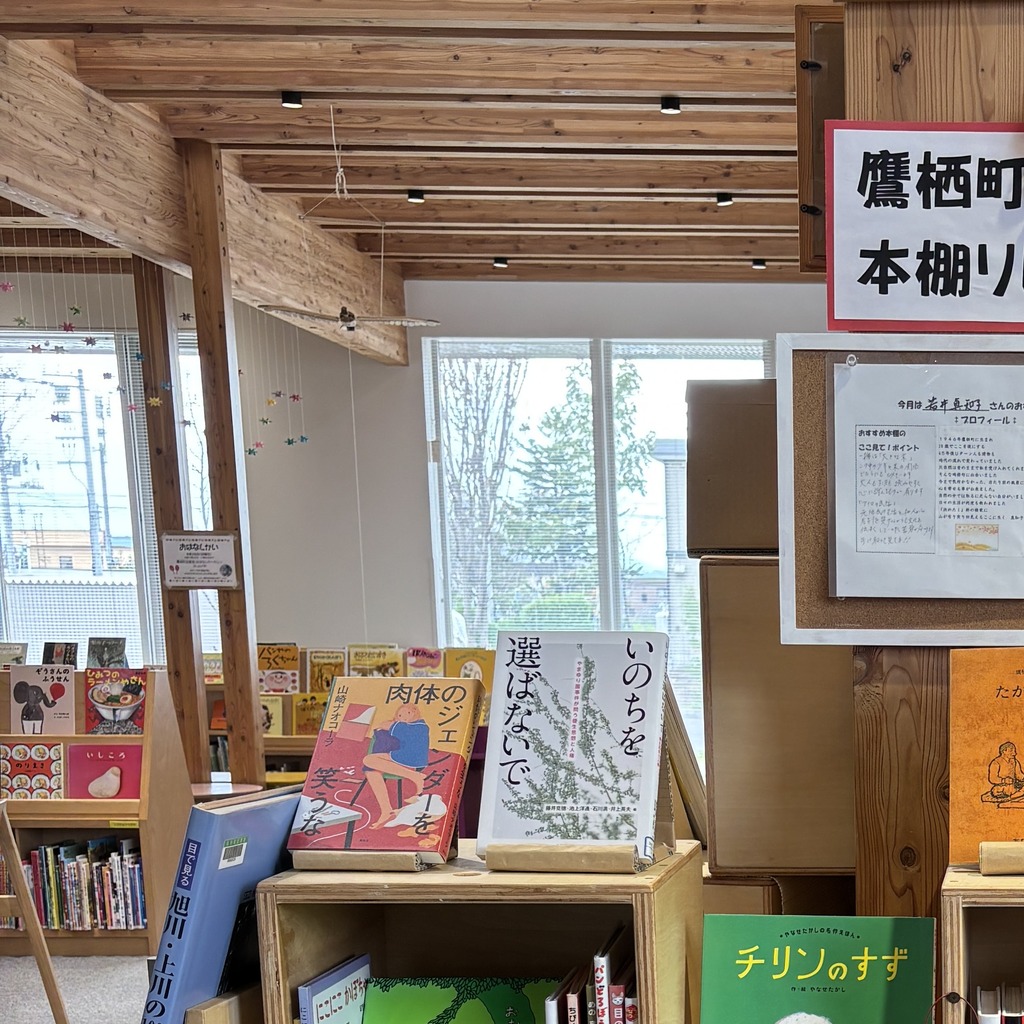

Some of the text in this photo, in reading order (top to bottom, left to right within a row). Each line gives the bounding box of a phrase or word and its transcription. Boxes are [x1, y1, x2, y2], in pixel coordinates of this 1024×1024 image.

[898, 401, 922, 410] 今月は
[961, 416, 1010, 424] プロフィール
[179, 543, 219, 551] おはなしかい
[258, 646, 292, 658] パンやの
[261, 655, 298, 669] ろくちゃん
[86, 670, 120, 678] ひみつの
[88, 676, 146, 686] ラーメンやさん
[385, 684, 467, 705] 肉体の
[620, 637, 654, 756] いのちを
[325, 685, 349, 747] 山崎ナオコーラ
[499, 637, 542, 785] 選ばないで
[86, 751, 126, 759] いしころ
[301, 767, 340, 836] 笑うな
[179, 841, 199, 887] 目で見る
[784, 927, 855, 939] やなせたかしの名作えほん
[735, 945, 908, 982] チリンのすず
[316, 991, 344, 1024] にこにこ
